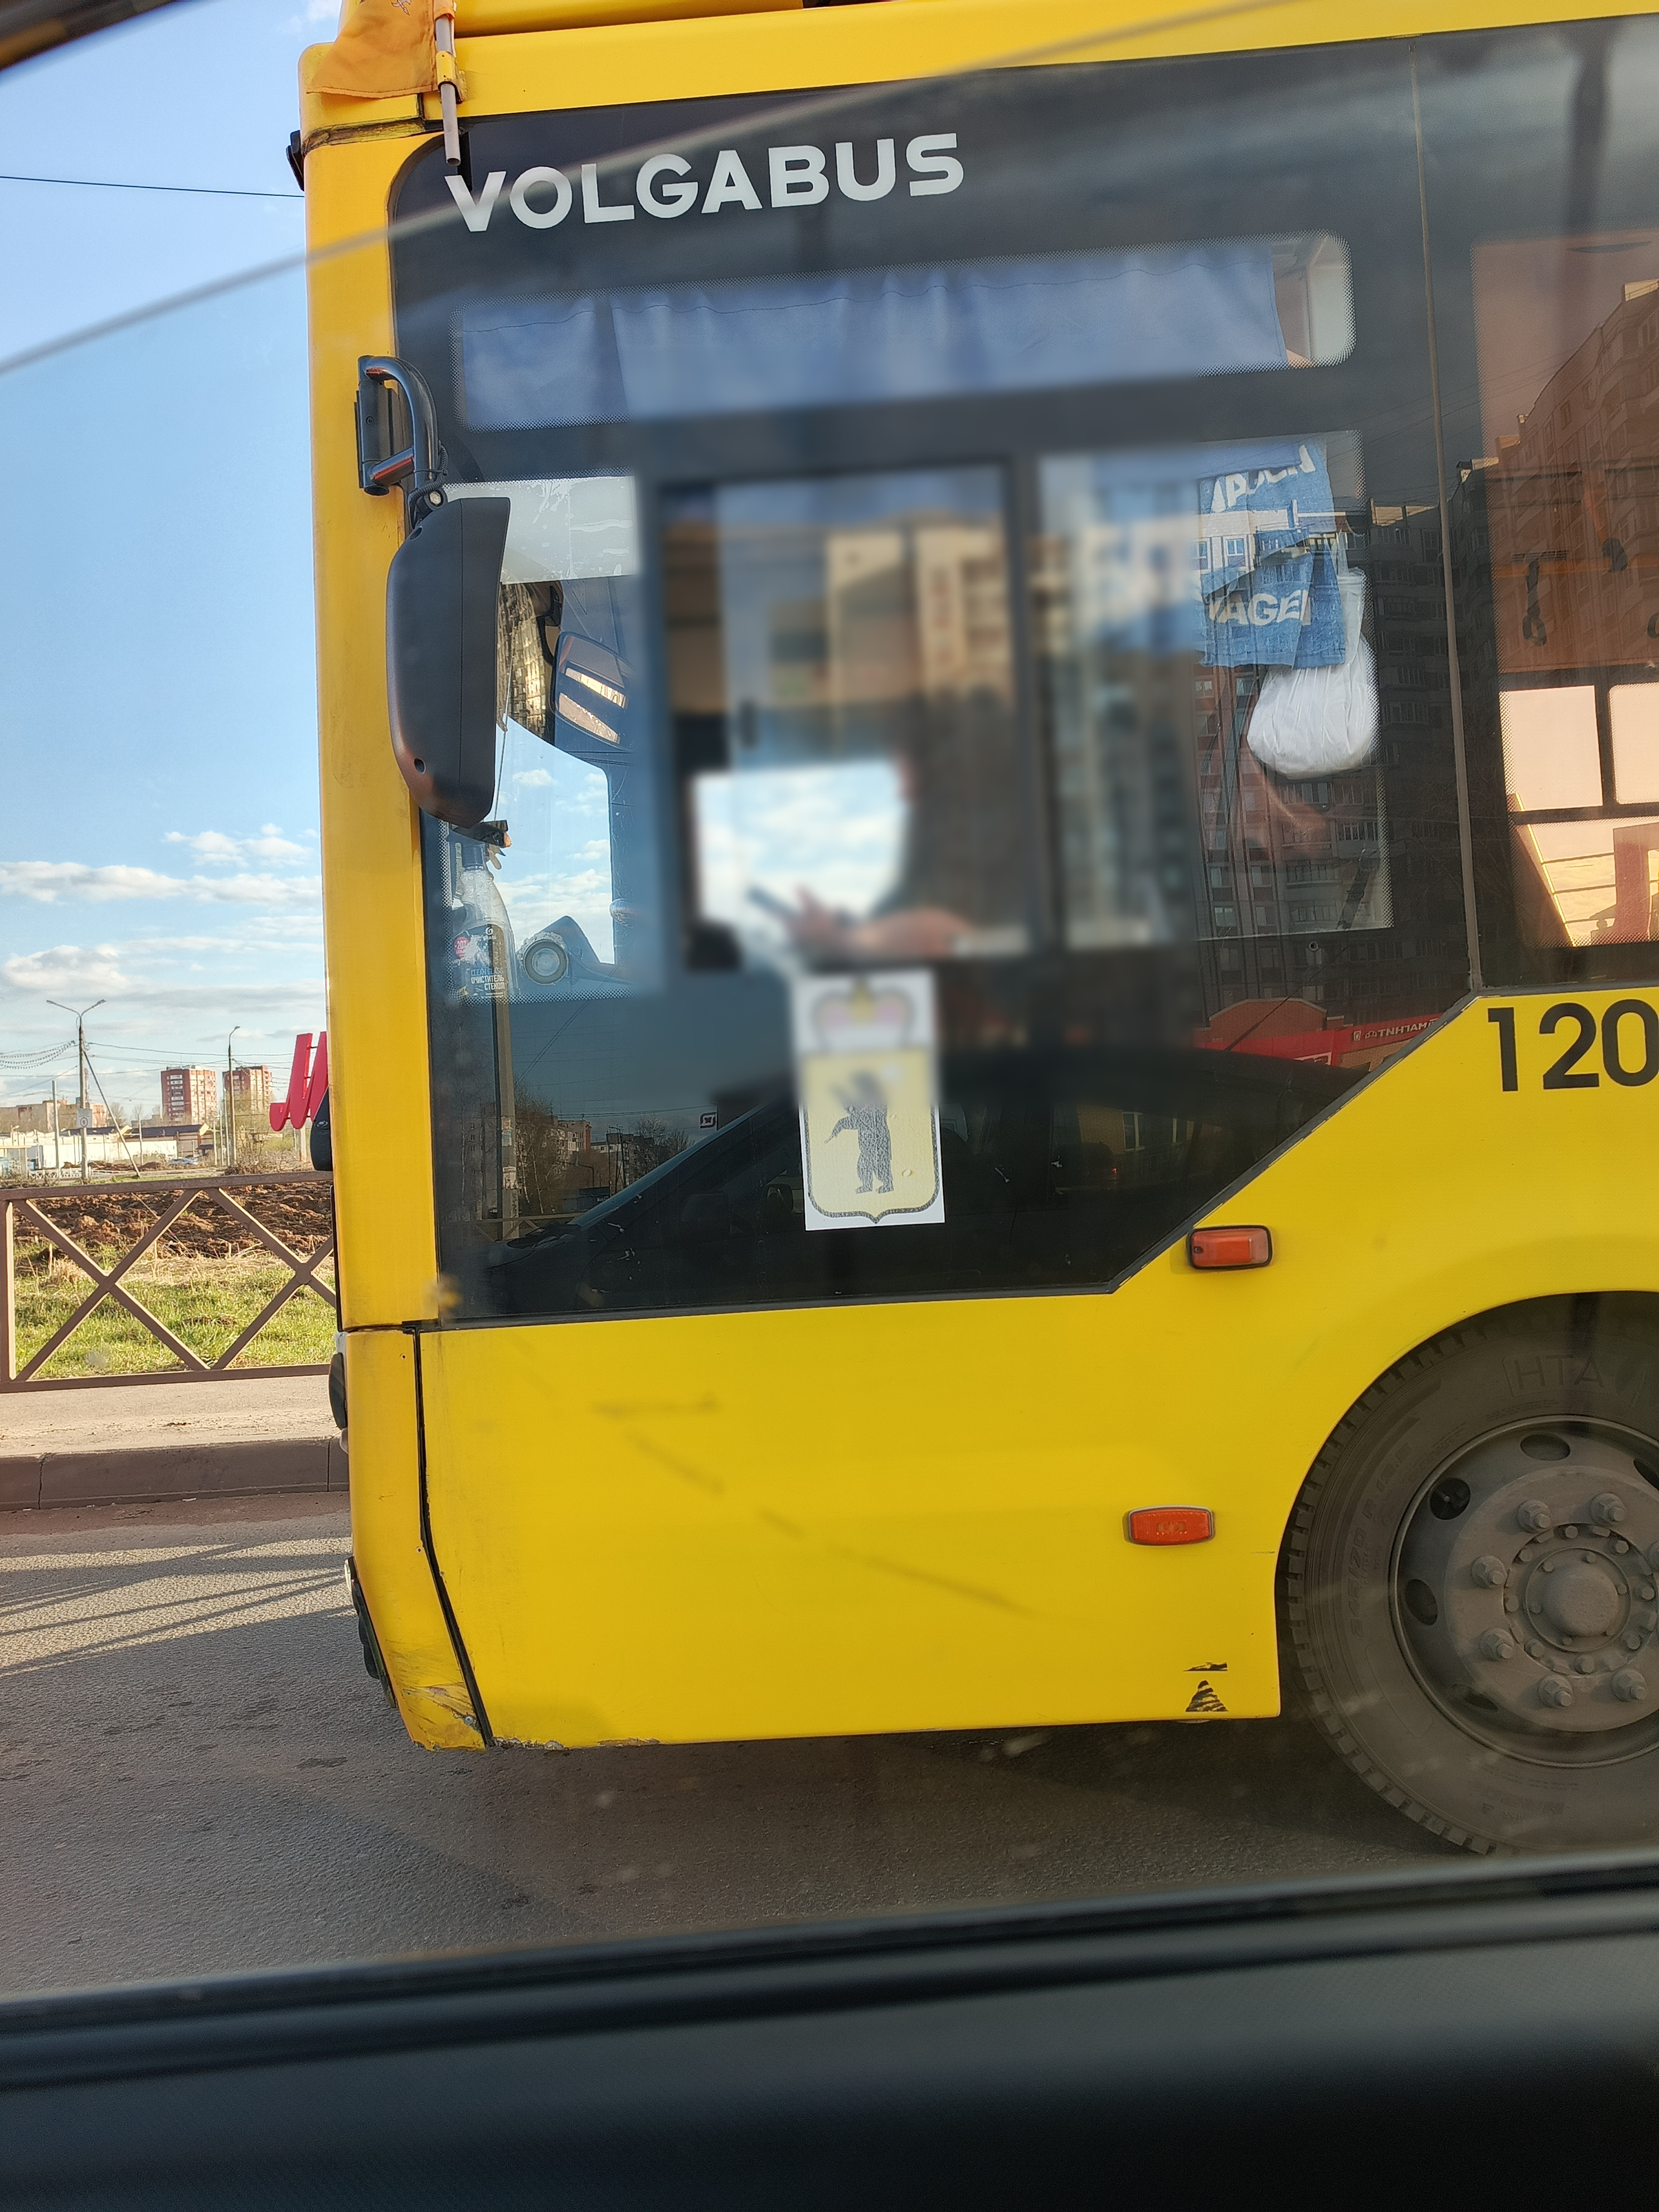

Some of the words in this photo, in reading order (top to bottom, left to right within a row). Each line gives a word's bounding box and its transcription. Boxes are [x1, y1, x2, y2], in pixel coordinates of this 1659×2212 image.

[445, 133, 964, 232] VOLGABUS
[471, 974, 505, 984] ОЧИСТИТЕЛЬ
[484, 982, 505, 991] СТЕКОЛ
[1488, 999, 1659, 1092] 120
